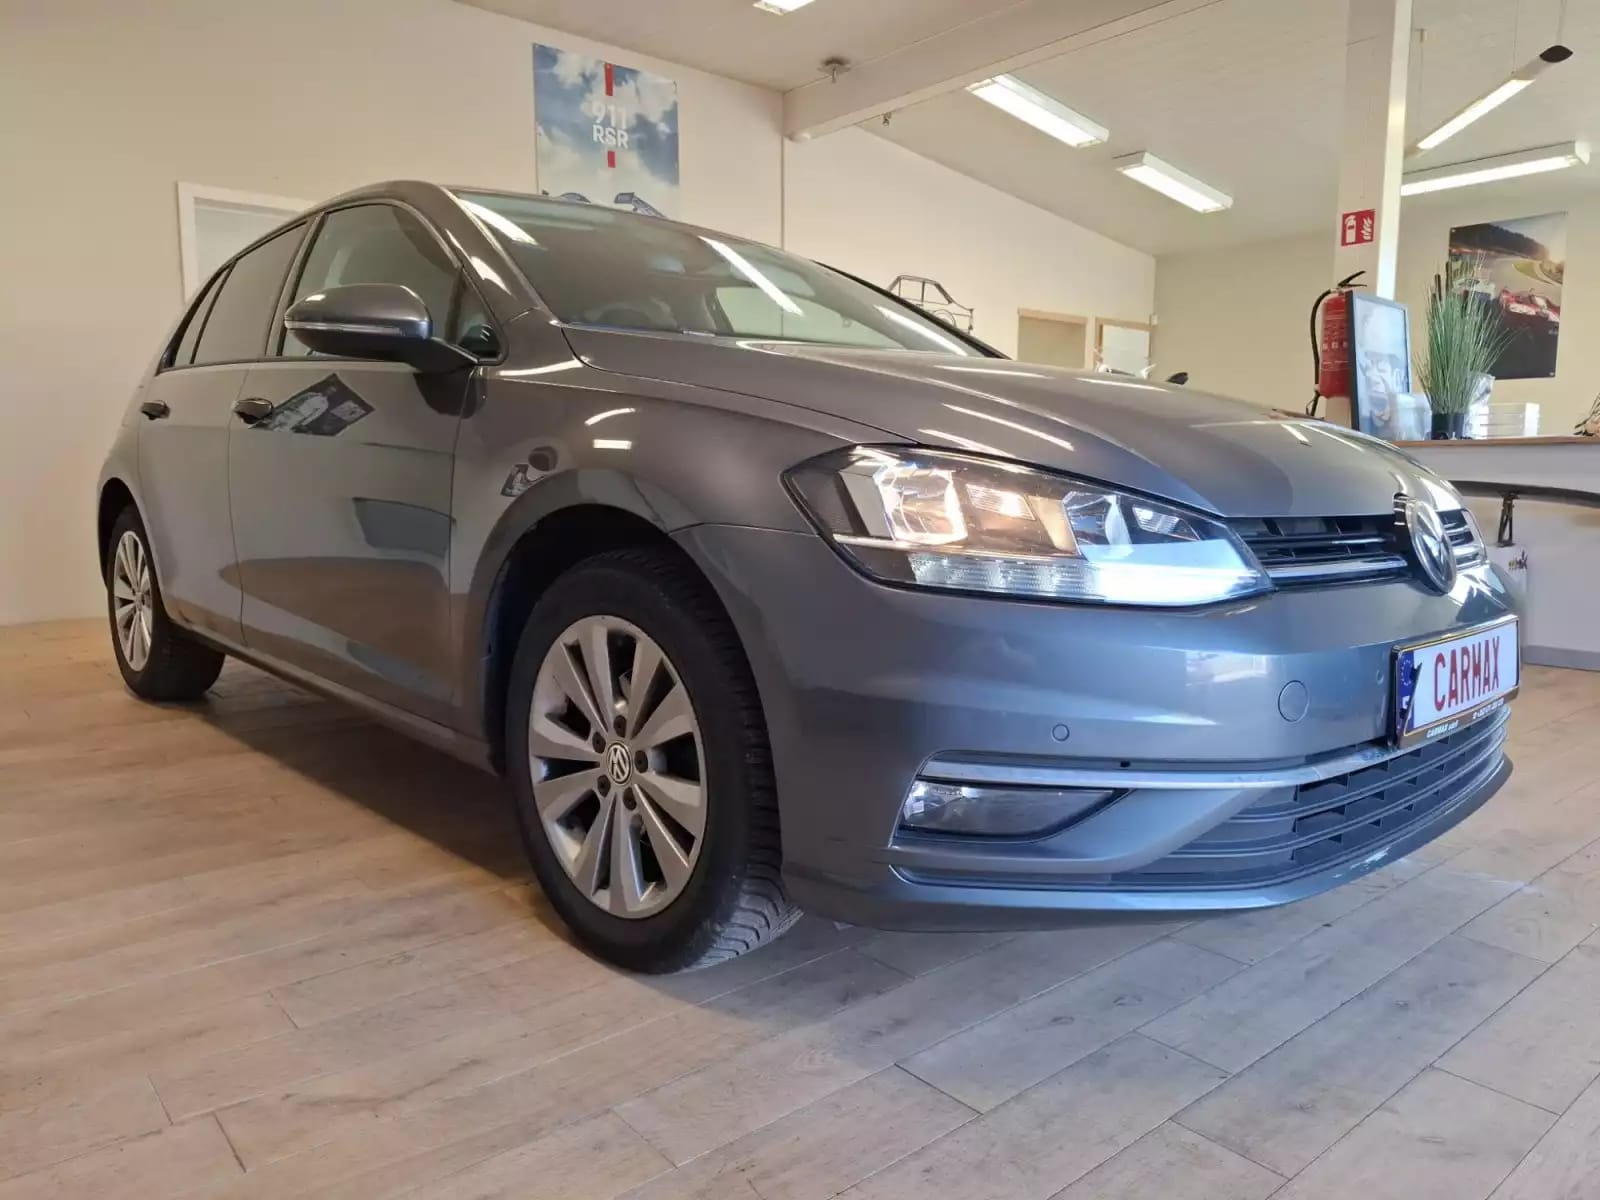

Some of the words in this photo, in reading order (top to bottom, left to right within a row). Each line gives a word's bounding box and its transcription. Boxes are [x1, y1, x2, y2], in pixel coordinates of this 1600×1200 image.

[592, 101, 628, 130] 911
[592, 124, 629, 149] RSR
[1434, 635, 1500, 712] CARMAX
